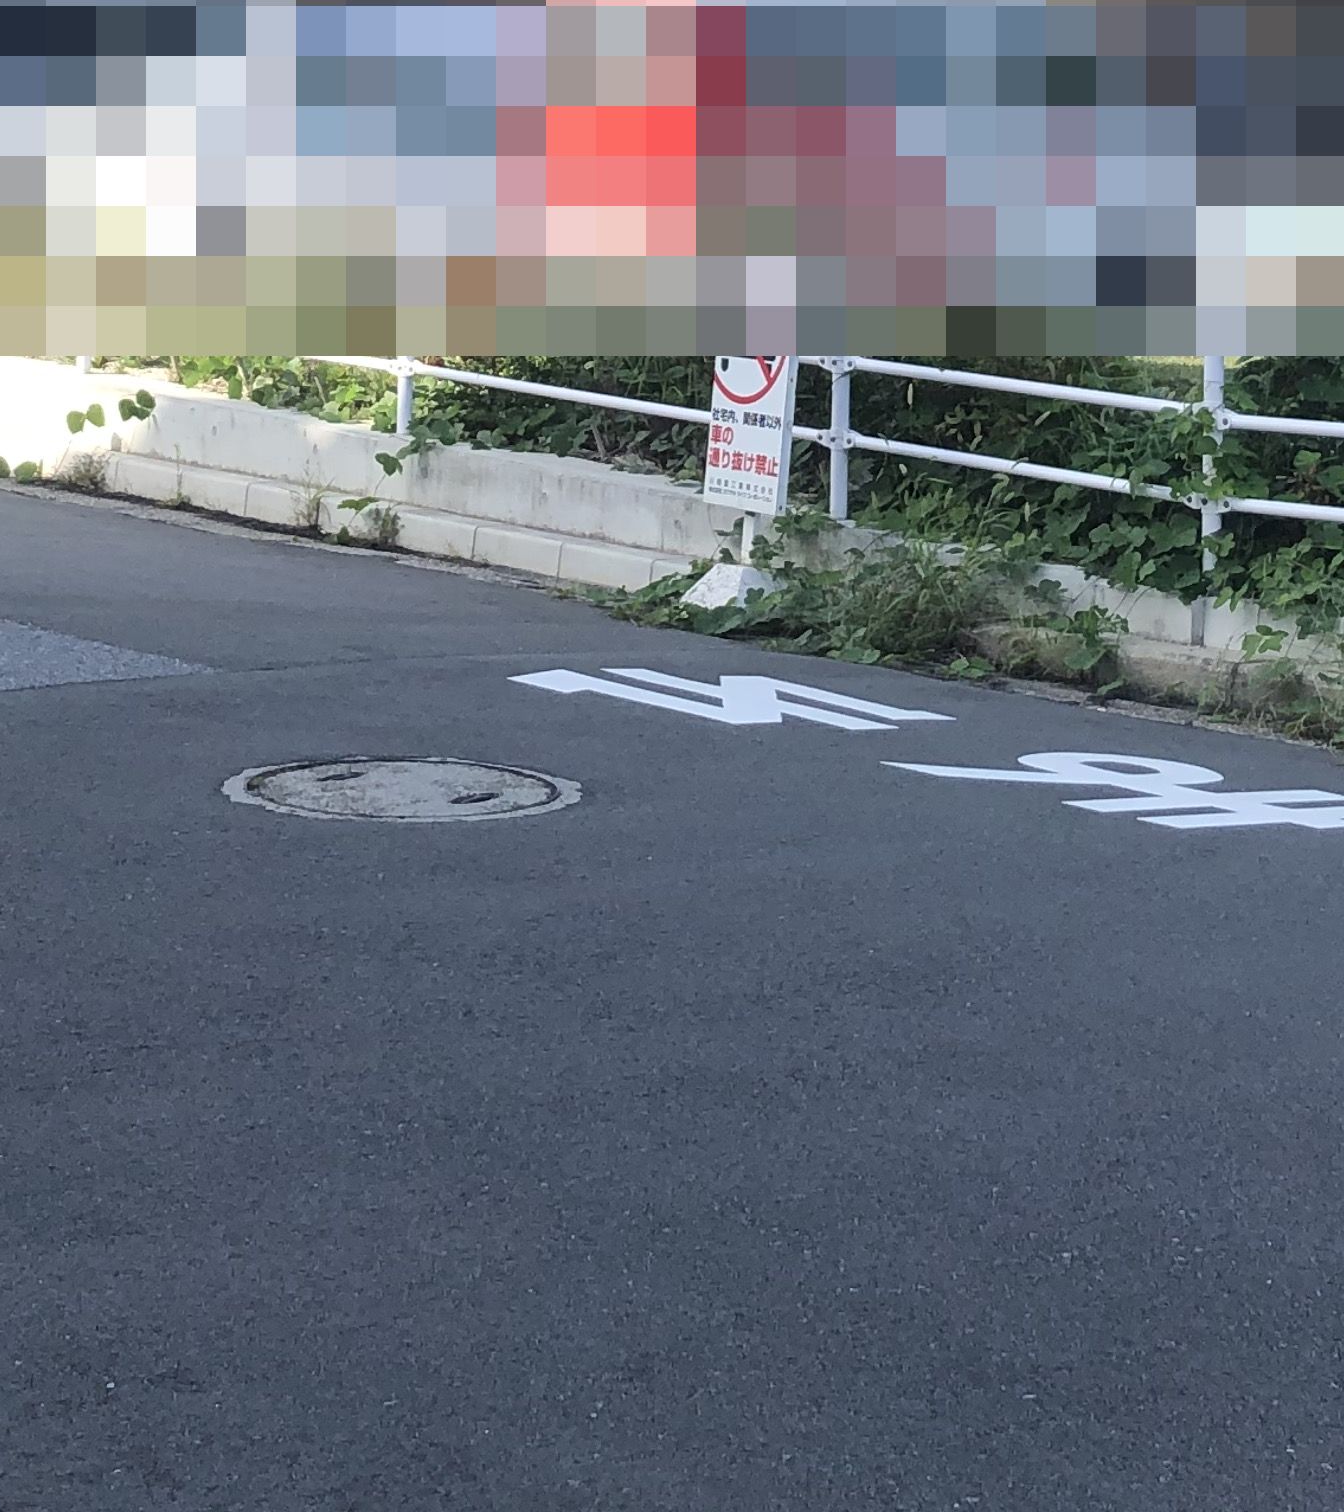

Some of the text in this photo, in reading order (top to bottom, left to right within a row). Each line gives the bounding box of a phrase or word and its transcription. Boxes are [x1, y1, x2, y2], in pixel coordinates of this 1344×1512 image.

[710, 424, 735, 446] 車の
[708, 446, 779, 478] 通り抜け禁止
